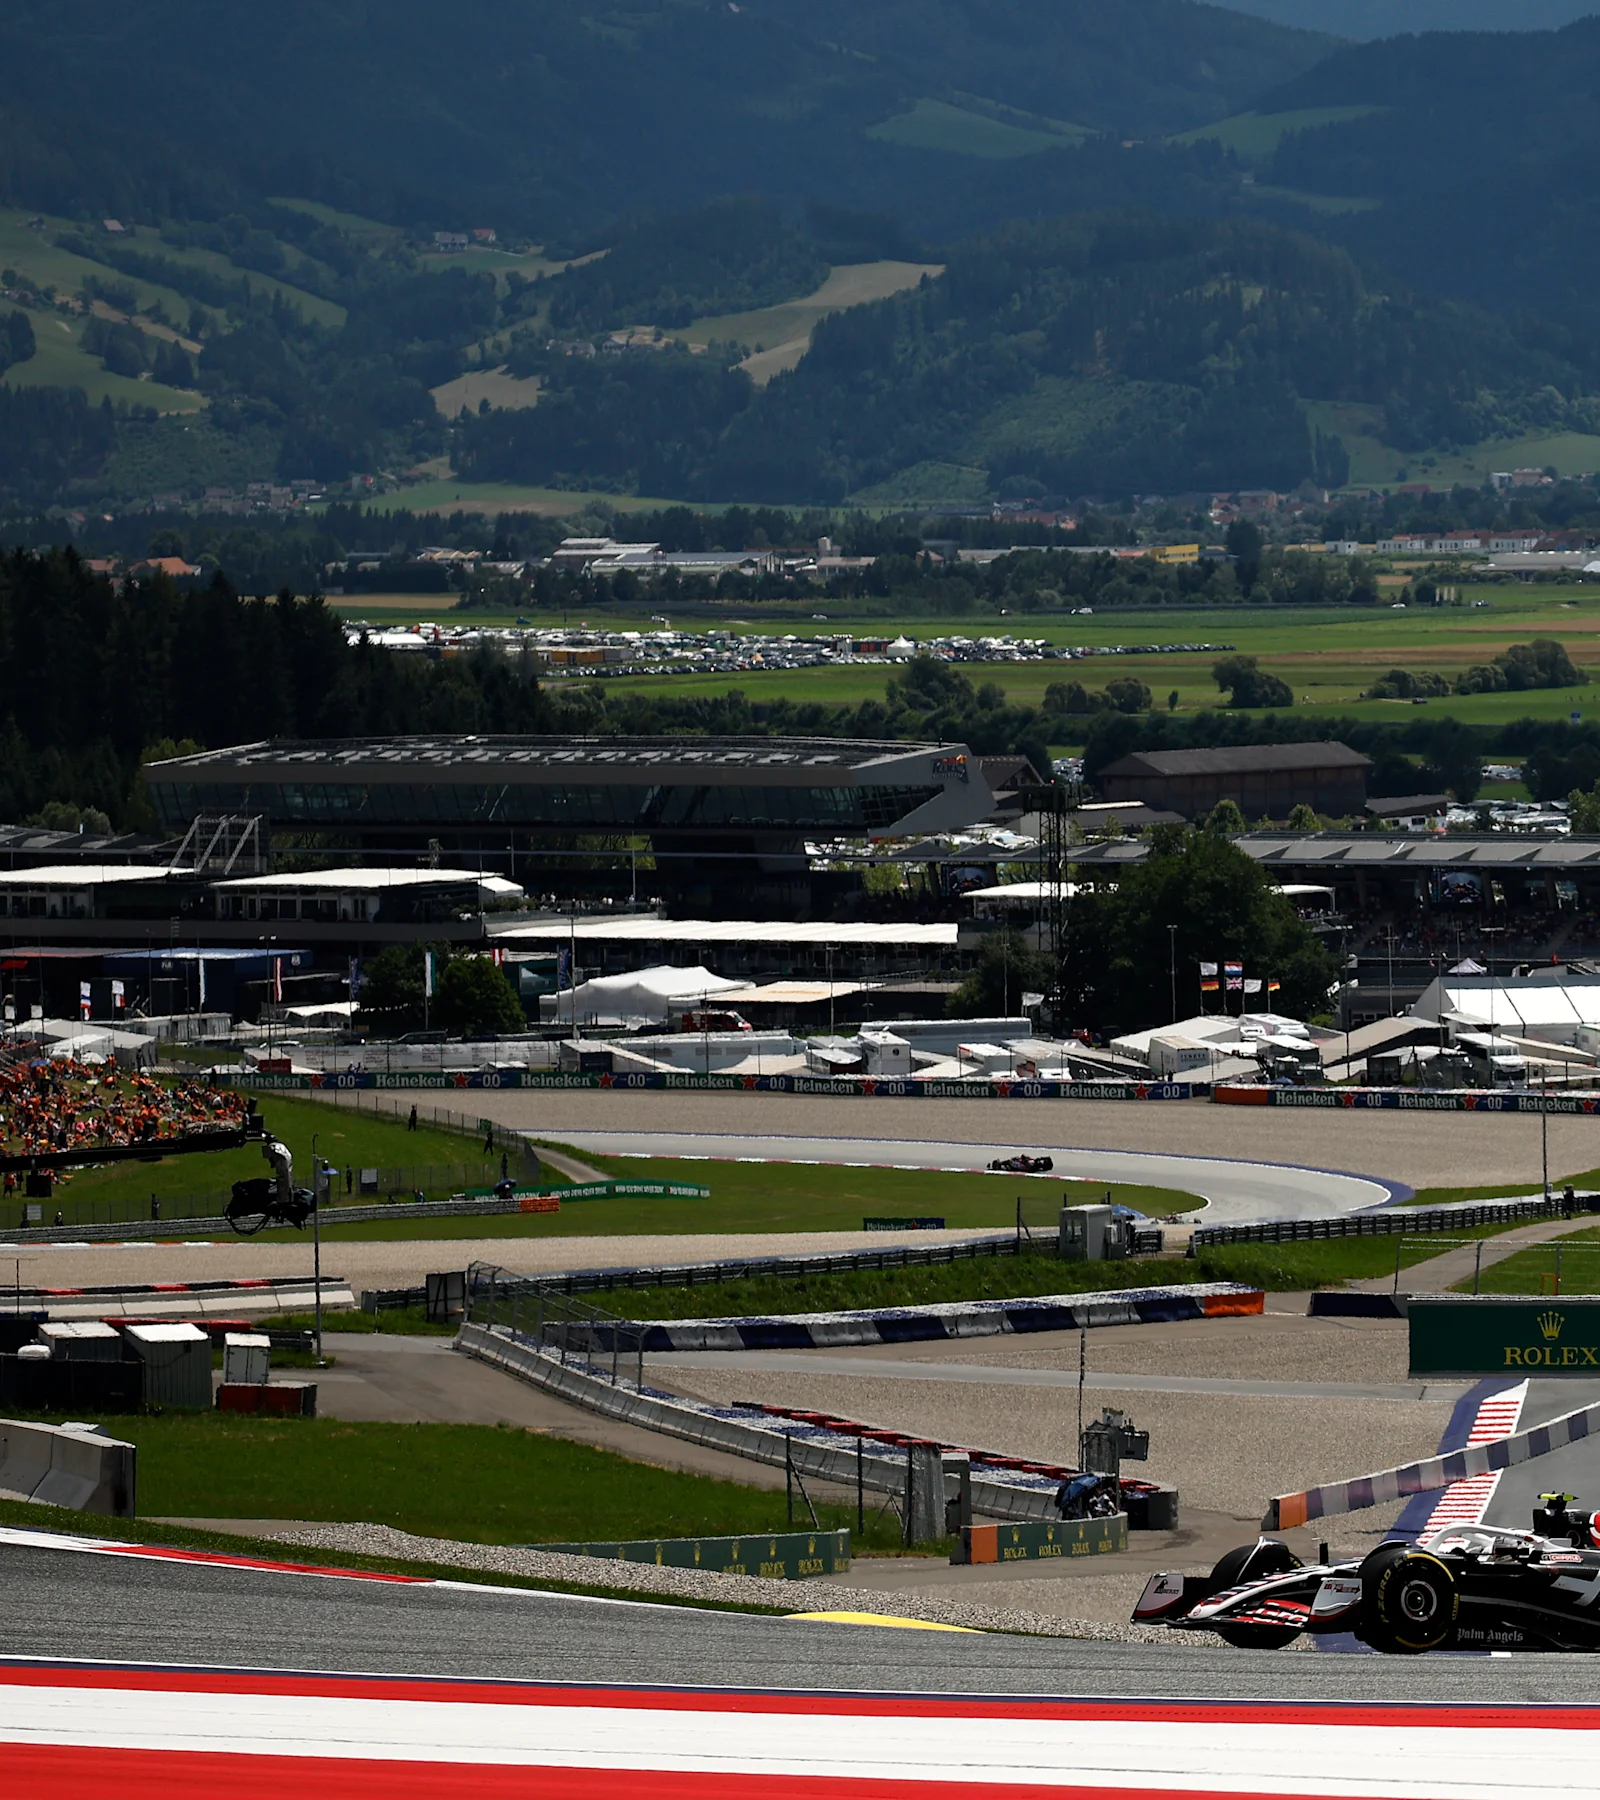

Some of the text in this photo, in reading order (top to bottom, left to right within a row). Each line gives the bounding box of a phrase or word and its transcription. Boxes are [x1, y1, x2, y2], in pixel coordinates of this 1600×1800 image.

[375, 1073, 446, 1088] Heineken
[520, 1073, 591, 1088] Heineken
[664, 1074, 735, 1089] Heineken
[793, 1079, 855, 1095] Heineken
[923, 1082, 989, 1097] Heineken
[1059, 1083, 1126, 1098] Heineken
[1275, 1091, 1336, 1107] Heineken
[1398, 1094, 1458, 1109] Heineken
[1518, 1096, 1577, 1112] Heineken
[1503, 1346, 1599, 1367] ROLEX
[1457, 1627, 1524, 1643] Palm Angels
